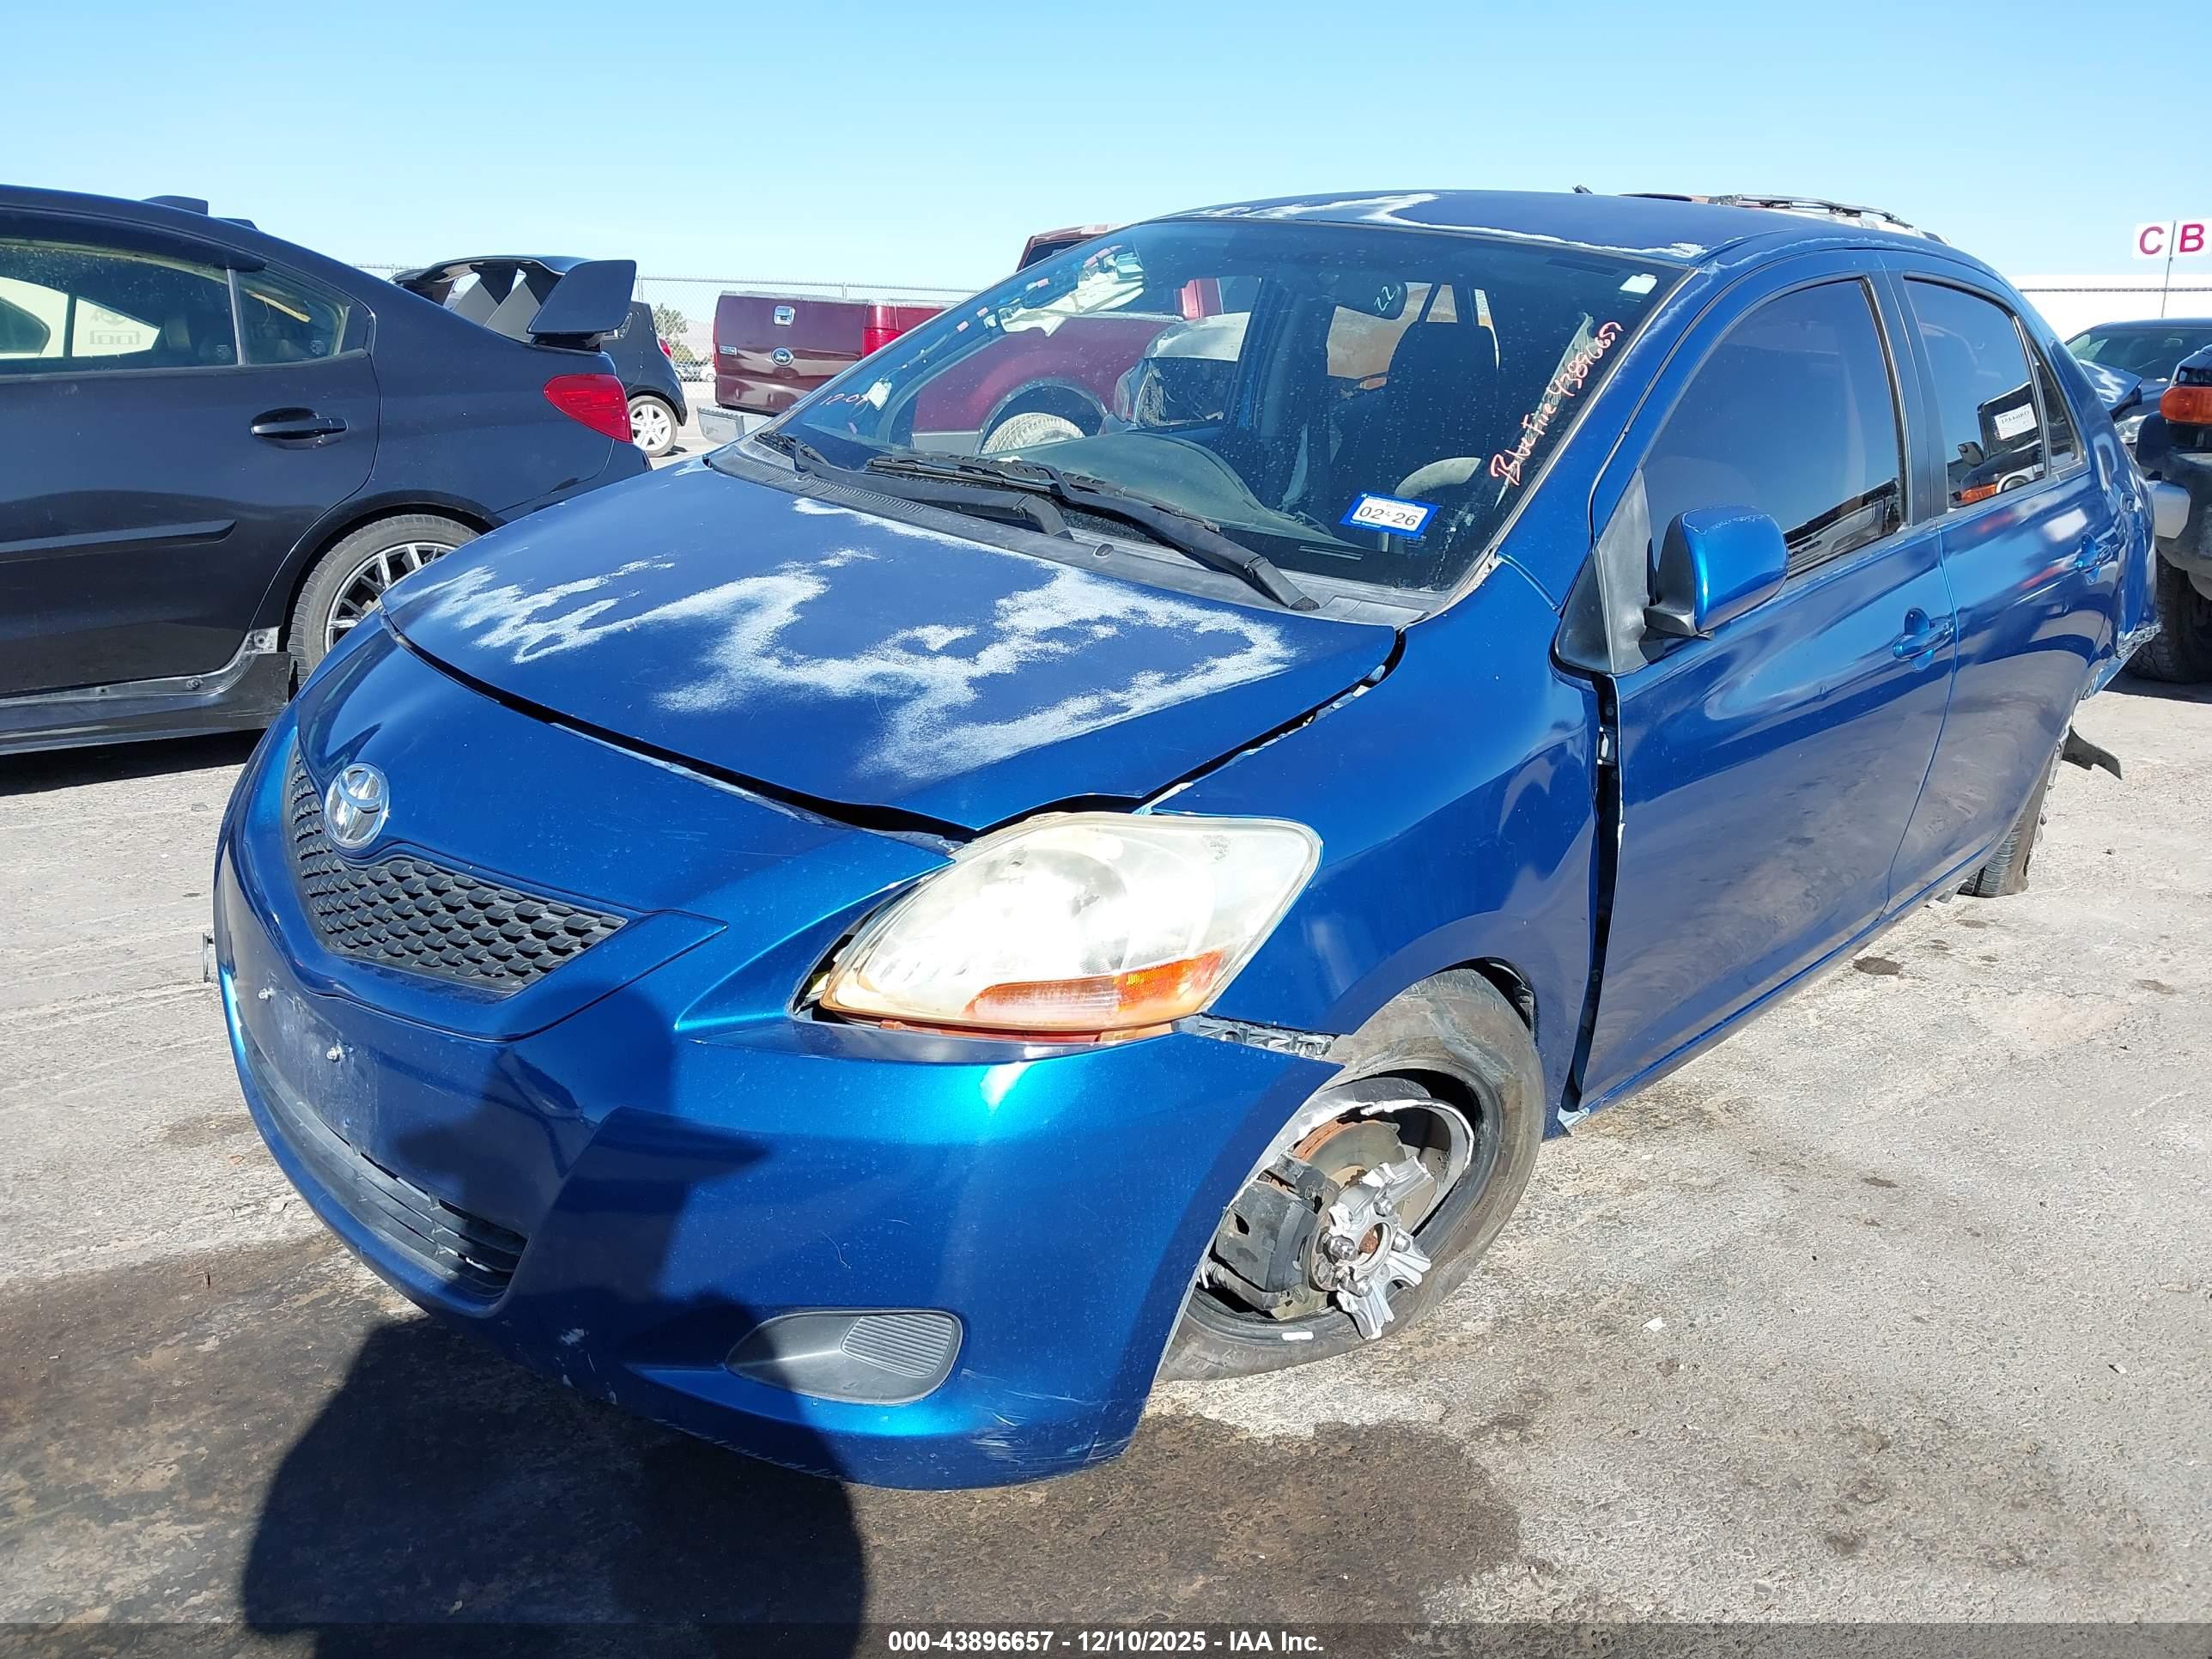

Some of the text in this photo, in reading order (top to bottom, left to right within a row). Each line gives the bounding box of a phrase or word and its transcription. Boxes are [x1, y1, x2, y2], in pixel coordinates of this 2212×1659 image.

[2139, 226, 2165, 255] C
[2179, 223, 2205, 252] B
[1358, 506, 1385, 520] 02
[1391, 512, 1419, 526] 26
